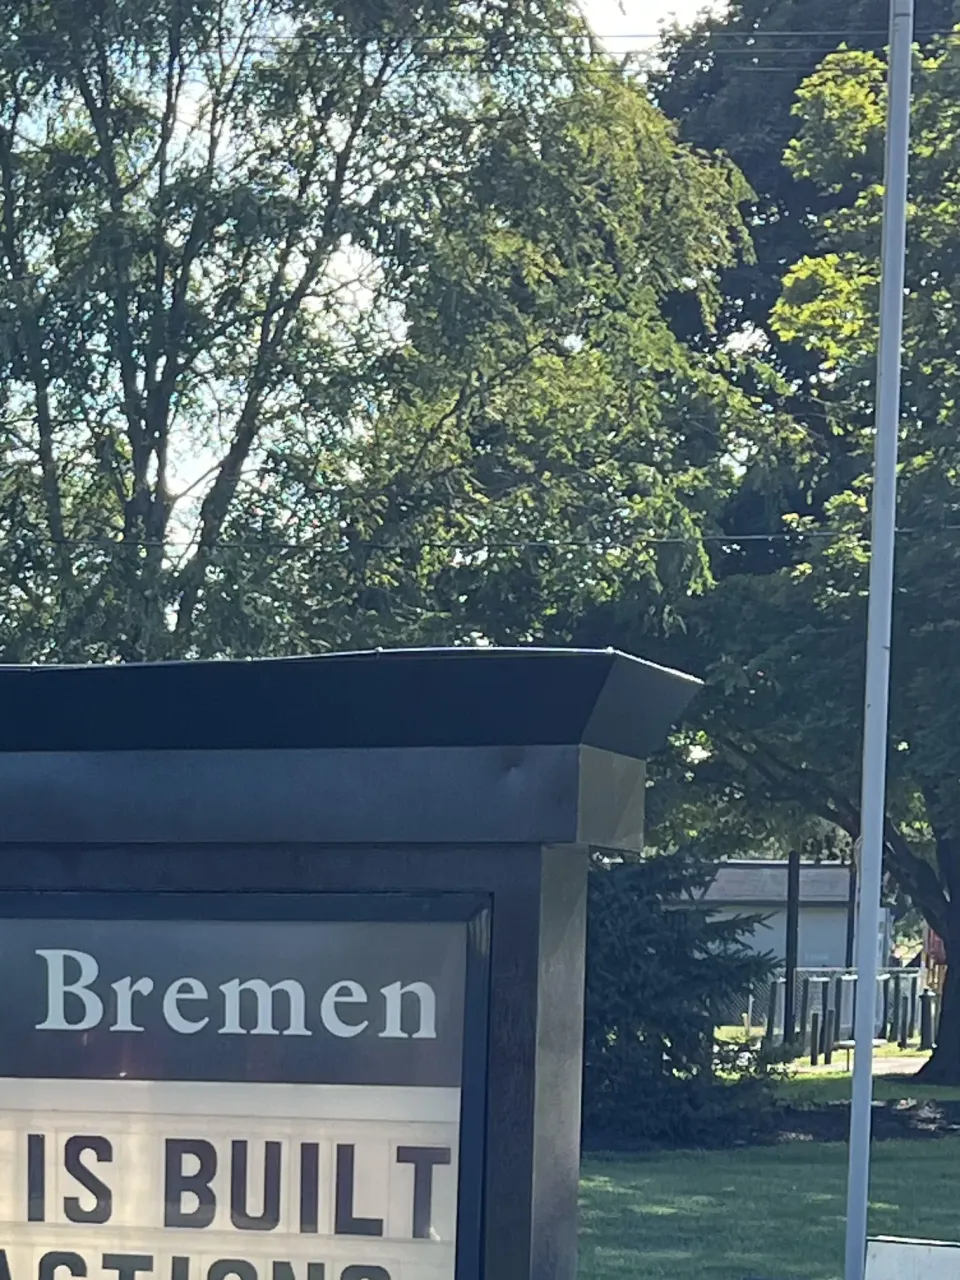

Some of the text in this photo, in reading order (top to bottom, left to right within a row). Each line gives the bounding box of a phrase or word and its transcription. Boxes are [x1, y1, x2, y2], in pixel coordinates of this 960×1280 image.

[35, 949, 436, 1039] Bremen
[28, 1134, 113, 1224] IS
[164, 1138, 450, 1239] BUILT
